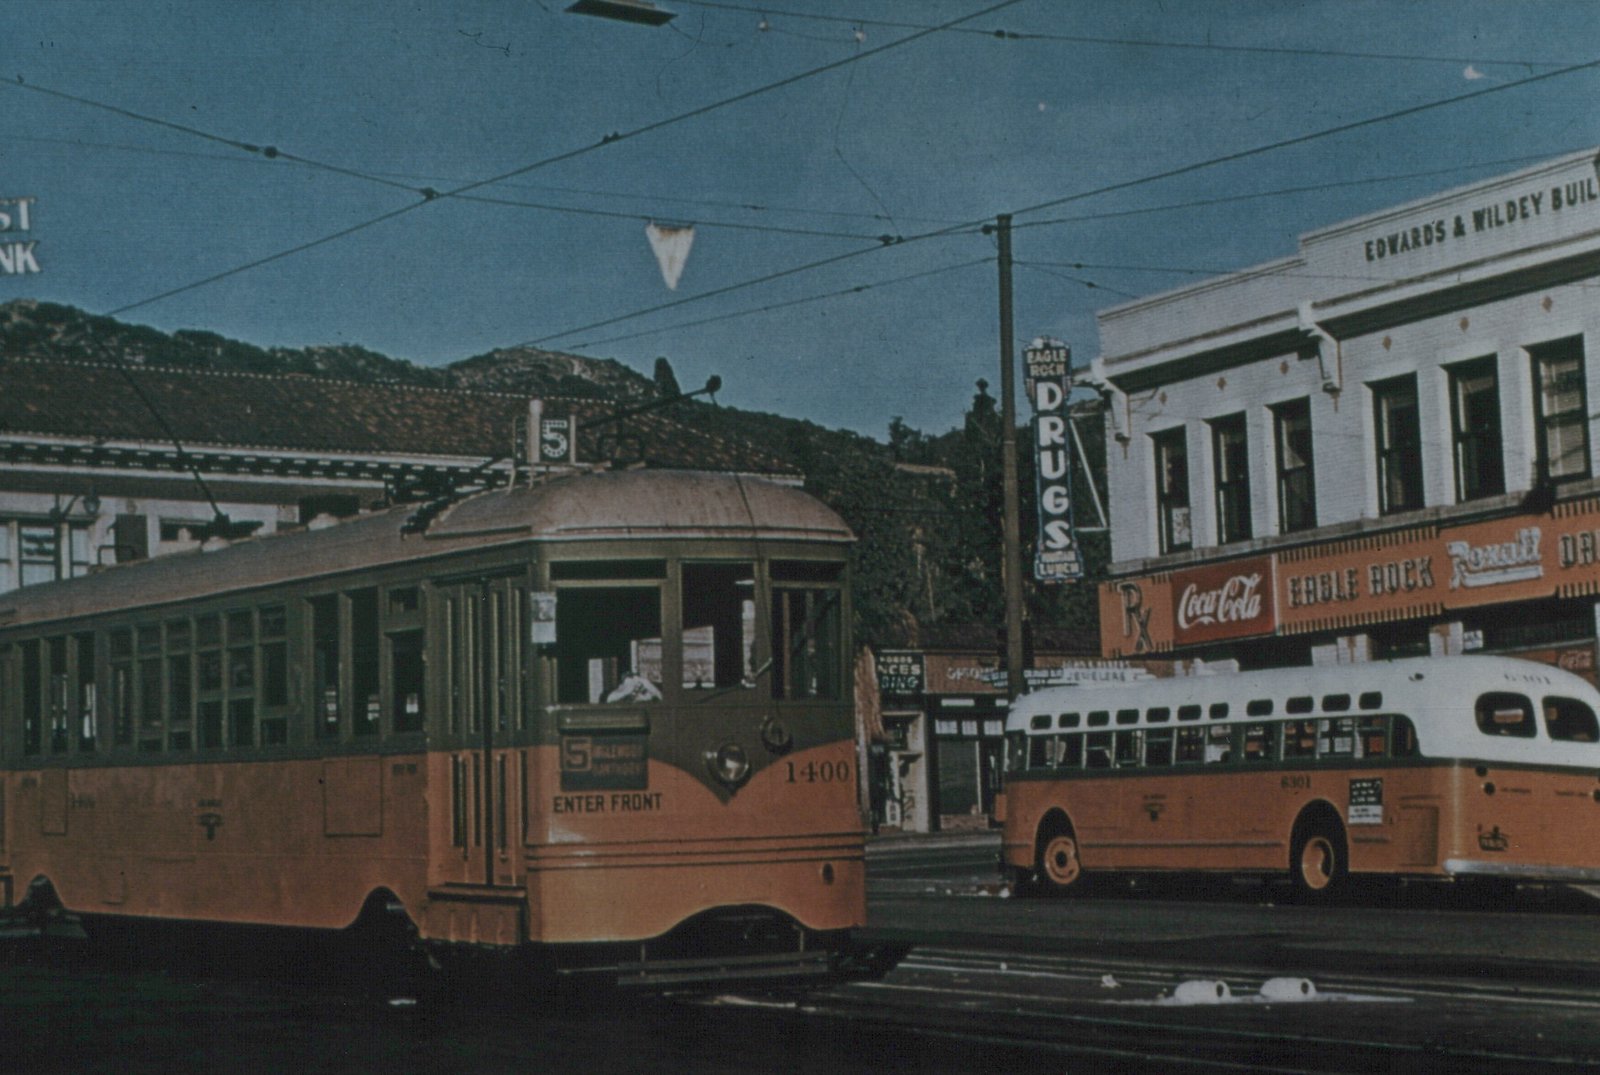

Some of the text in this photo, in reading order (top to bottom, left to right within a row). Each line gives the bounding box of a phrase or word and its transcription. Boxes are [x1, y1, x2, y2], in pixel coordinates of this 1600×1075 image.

[1453, 215, 1466, 238] &
[1472, 191, 1544, 232] WILDEY
[1551, 177, 1598, 211] BUIL
[542, 419, 568, 458] 5
[1036, 382, 1070, 549] DRUGS
[1558, 530, 1600, 573] DR
[1287, 555, 1435, 608] EAGLE ROCK
[566, 737, 590, 769] 5
[785, 760, 849, 782] 1400
[553, 793, 662, 814] ENTER FRONT
